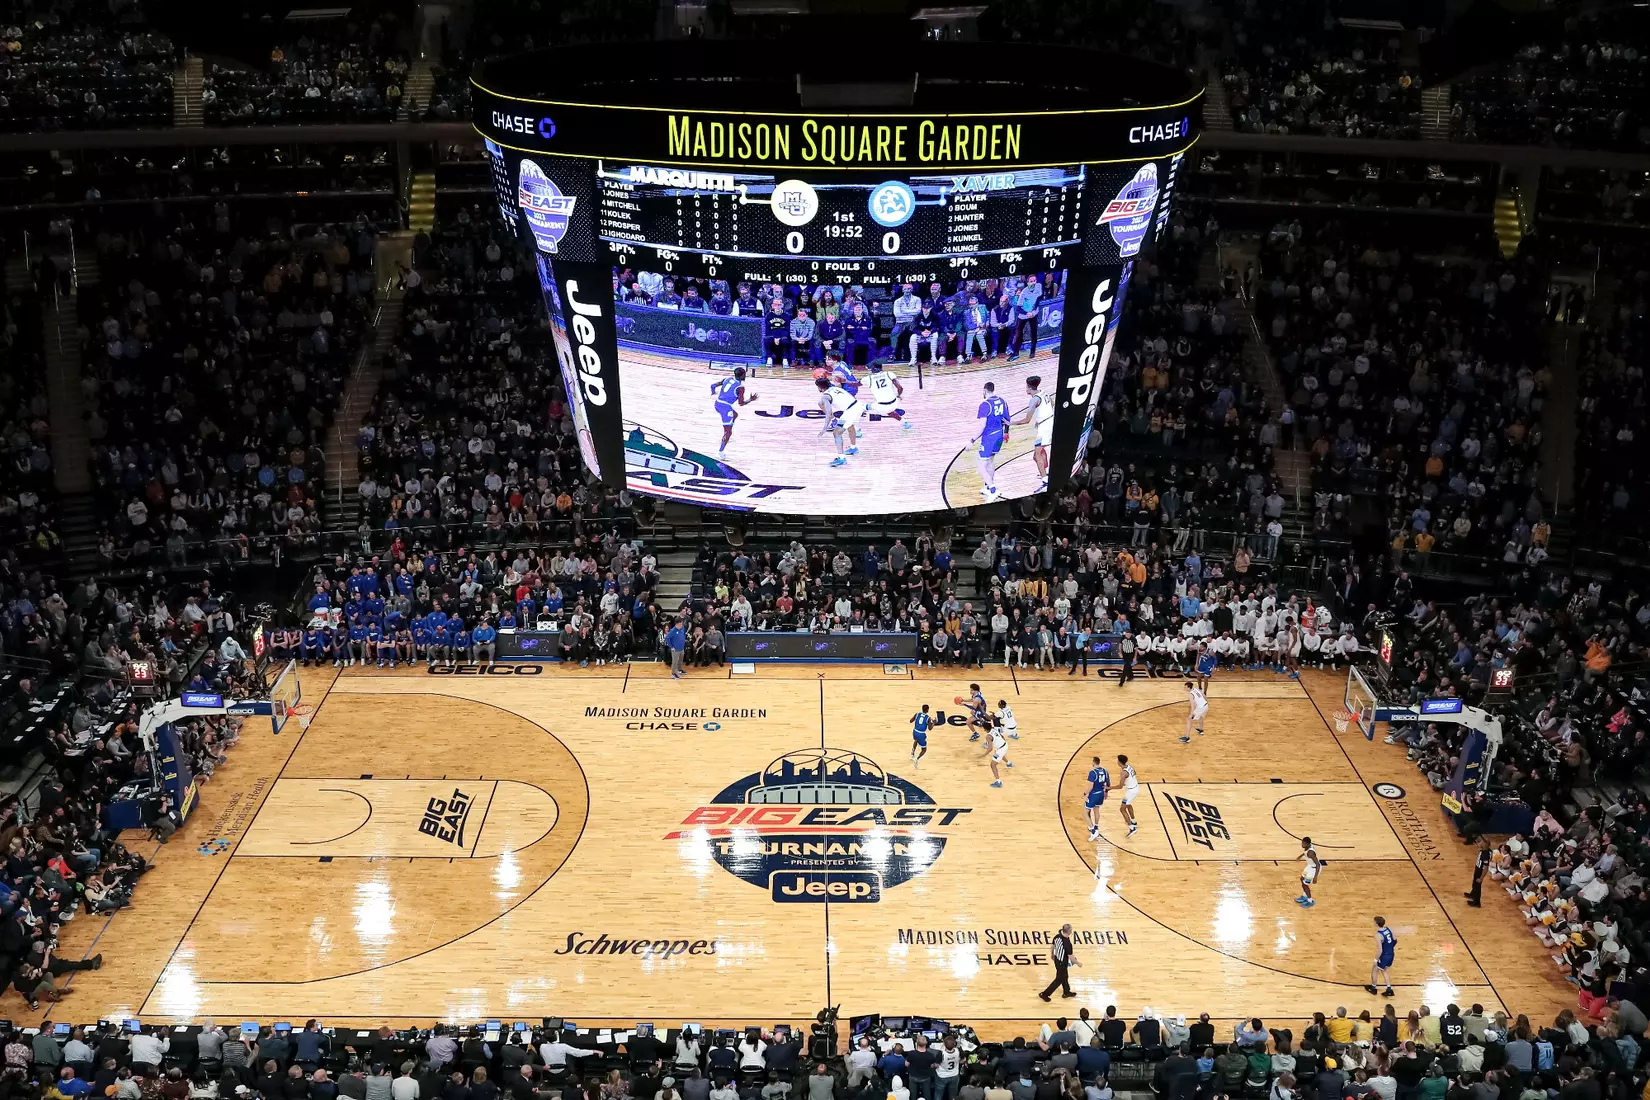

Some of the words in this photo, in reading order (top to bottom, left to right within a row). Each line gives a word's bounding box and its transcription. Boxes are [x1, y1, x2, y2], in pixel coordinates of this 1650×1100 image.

[492, 110, 535, 134] CHASE
[668, 116, 790, 160] MADISON
[801, 119, 907, 164] SQUARE
[918, 120, 1021, 162] GARDEN
[1129, 121, 1180, 143] CHASE
[605, 181, 634, 191] PLAYER
[950, 174, 1015, 193] XAVIER
[533, 196, 572, 209] EAST
[607, 201, 641, 211] MITCHELL
[955, 194, 986, 202] PLAYER
[1107, 201, 1138, 212] BIG
[608, 211, 631, 220] KOLEK
[833, 212, 854, 222] 1st
[608, 221, 640, 231] PROSPER
[824, 226, 862, 237] 19:52
[608, 231, 645, 241] IGHODARO
[786, 232, 804, 253] 0
[882, 232, 900, 253] 0
[609, 242, 635, 254] 3PT%
[657, 250, 679, 260] FG%
[702, 254, 722, 265] FT%
[950, 258, 978, 267] 3PT%
[1001, 254, 1022, 263] FG%
[1043, 248, 1061, 258] FT%
[619, 255, 626, 264] 0
[666, 262, 672, 271] 0
[709, 266, 716, 276] 0
[812, 262, 818, 270] 0
[868, 262, 875, 270] 0
[961, 268, 968, 278] 0
[1009, 264, 1015, 274] 0
[1050, 259, 1056, 268] 0
[745, 273, 771, 281] FULL:
[786, 275, 806, 283] (:30)
[812, 275, 818, 283] 3
[906, 275, 926, 283] (:30)
[566, 279, 607, 406] Jeep
[681, 323, 731, 346] Jeep
[1067, 278, 1113, 405] Jeep
[875, 379, 887, 388] 12
[994, 406, 1003, 416] 24
[135, 670, 146, 678] 23
[427, 665, 543, 675] GEICO
[585, 707, 648, 717] MADISON
[654, 706, 707, 718] SQUARE
[712, 708, 766, 718] GARDEN
[626, 722, 697, 730] CHASE
[207, 793, 243, 836] Hackensack
[224, 802, 254, 836] Meridian
[249, 776, 268, 800] Health
[419, 797, 448, 836] BIG
[438, 789, 470, 843] EAST
[680, 807, 803, 825] BIG
[799, 808, 973, 825] EAST
[1175, 796, 1214, 851] EAST
[1195, 801, 1230, 840] BIG
[1395, 801, 1444, 860] ROTHMAN
[781, 877, 871, 899] Jeep
[554, 932, 717, 959] Schweppes
[898, 929, 978, 944] MADISON
[986, 929, 1053, 945] SQUARE
[1073, 931, 1128, 944] ARDEN
[1387, 935, 1392, 943] 5
[976, 954, 1048, 965] HASE
[1447, 1025, 1462, 1035] 52
[948, 1062, 954, 1070] 3
